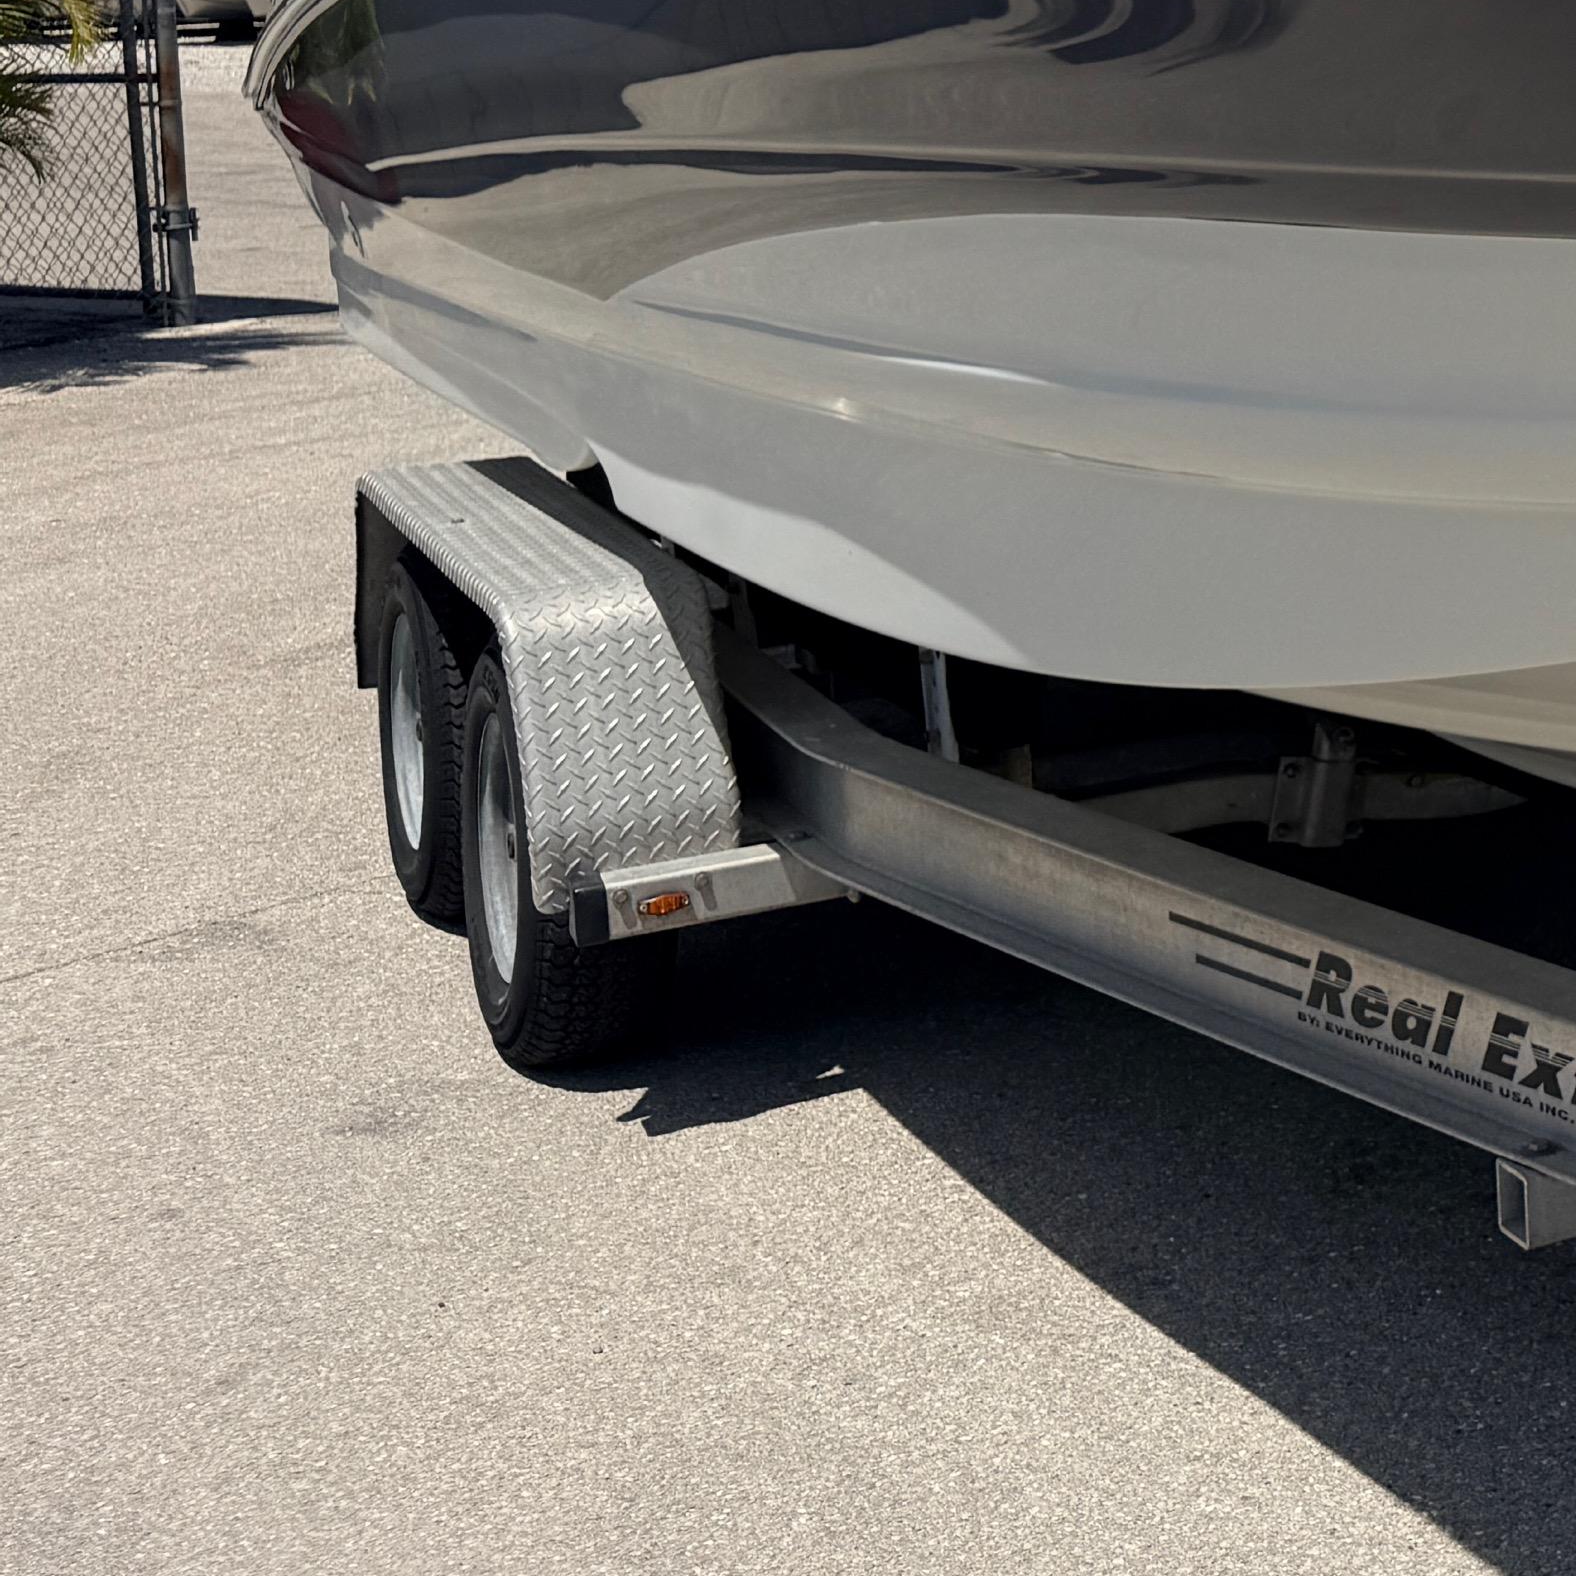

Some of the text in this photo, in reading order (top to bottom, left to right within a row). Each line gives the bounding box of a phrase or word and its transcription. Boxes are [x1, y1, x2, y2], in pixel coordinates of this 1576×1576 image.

[1306, 950, 1464, 1056] Real
[1325, 1022, 1422, 1065] EVERYTHING
[1429, 1059, 1493, 1093] MARINE
[1499, 1088, 1533, 1108] USA
